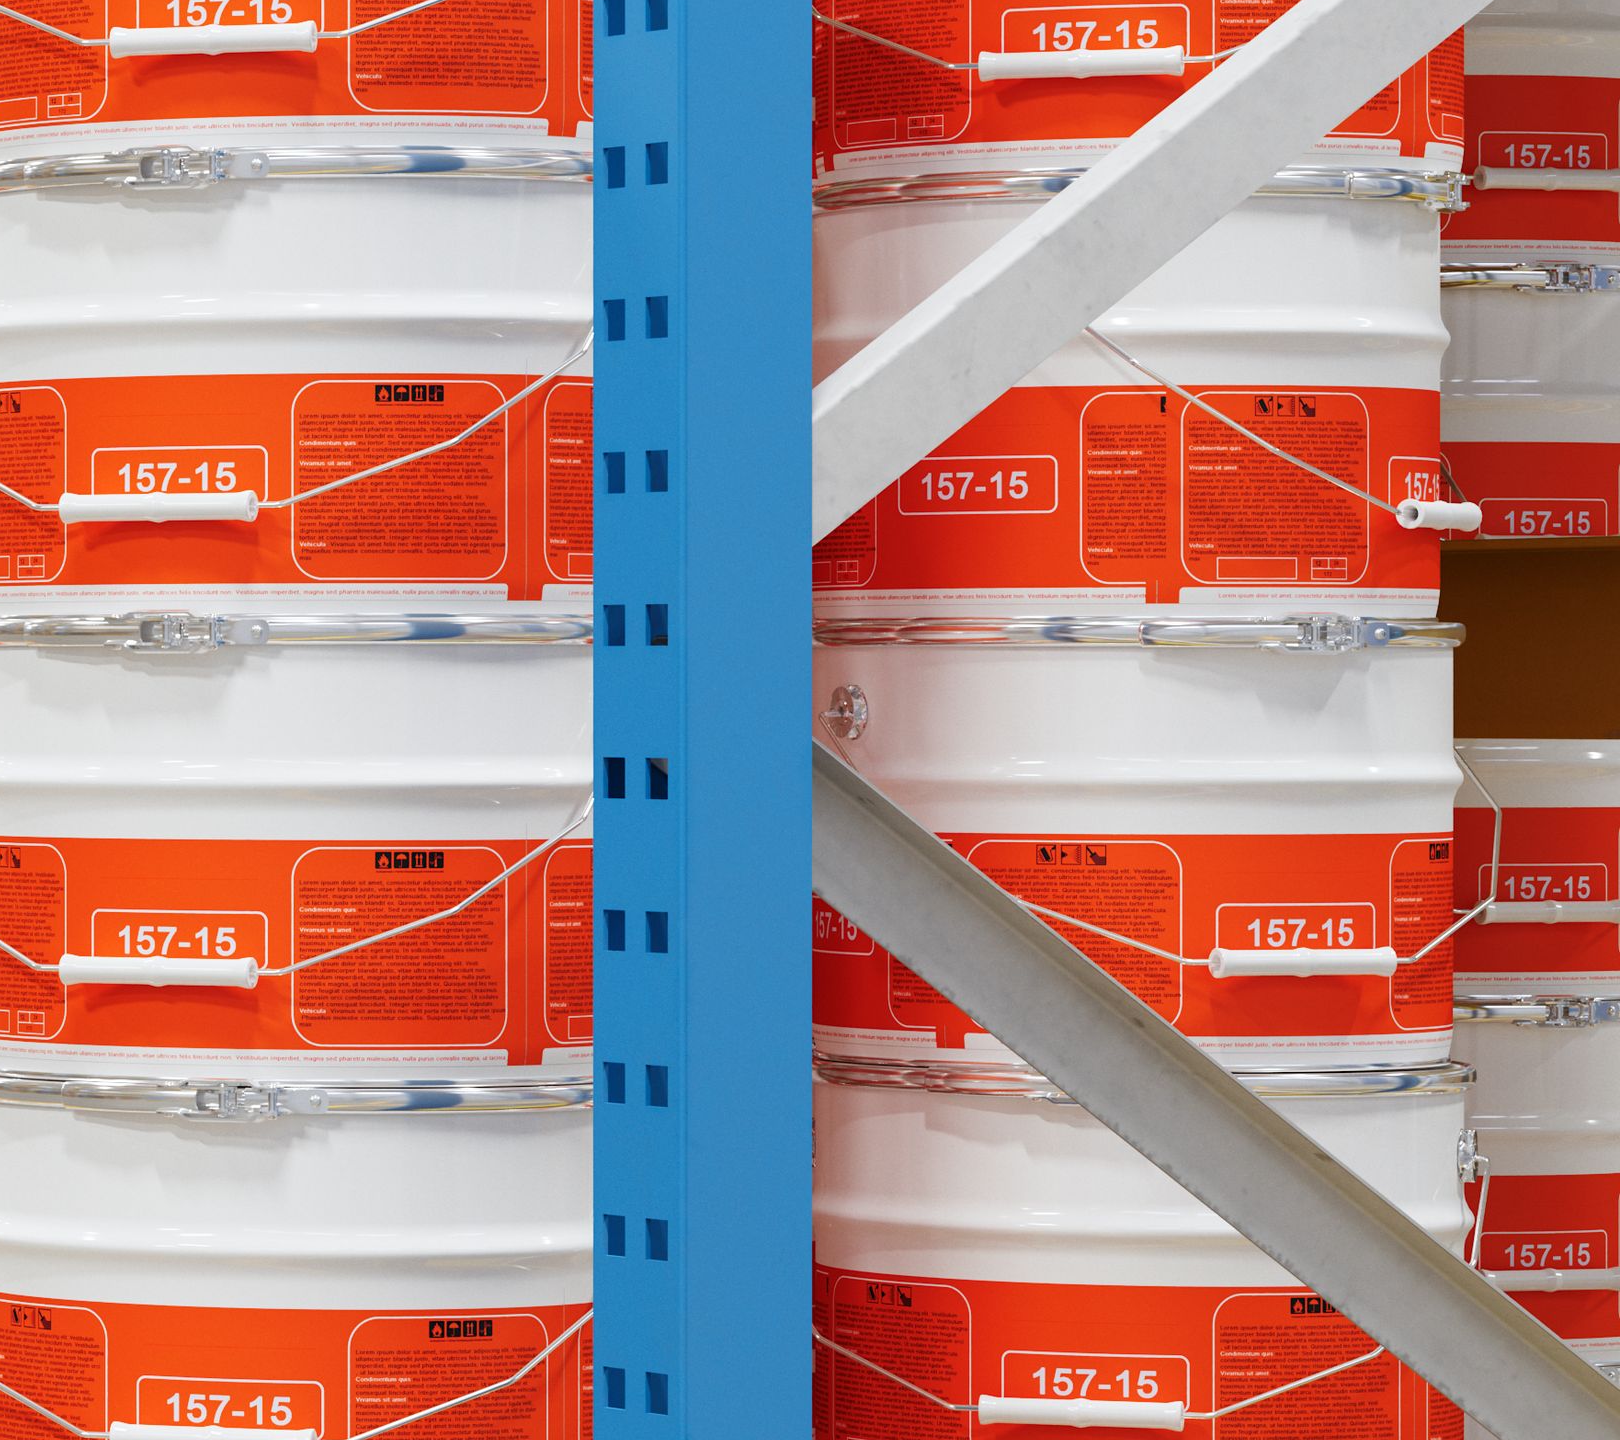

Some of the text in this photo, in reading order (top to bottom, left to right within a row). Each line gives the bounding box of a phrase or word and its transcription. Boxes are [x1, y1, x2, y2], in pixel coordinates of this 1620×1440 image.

[1033, 21, 1157, 50] 157-15
[1504, 144, 1590, 167] 157-15
[118, 462, 236, 492] 157-15
[921, 471, 1028, 500] 157-15
[1505, 511, 1591, 535] 157-15
[1505, 877, 1591, 899] 157-15
[118, 925, 237, 956] 157-15
[1247, 919, 1355, 948] 157-15
[1505, 1245, 1591, 1268] 157-15
[1032, 1368, 1156, 1398] 157-15
[166, 1393, 292, 1426] 157-15
